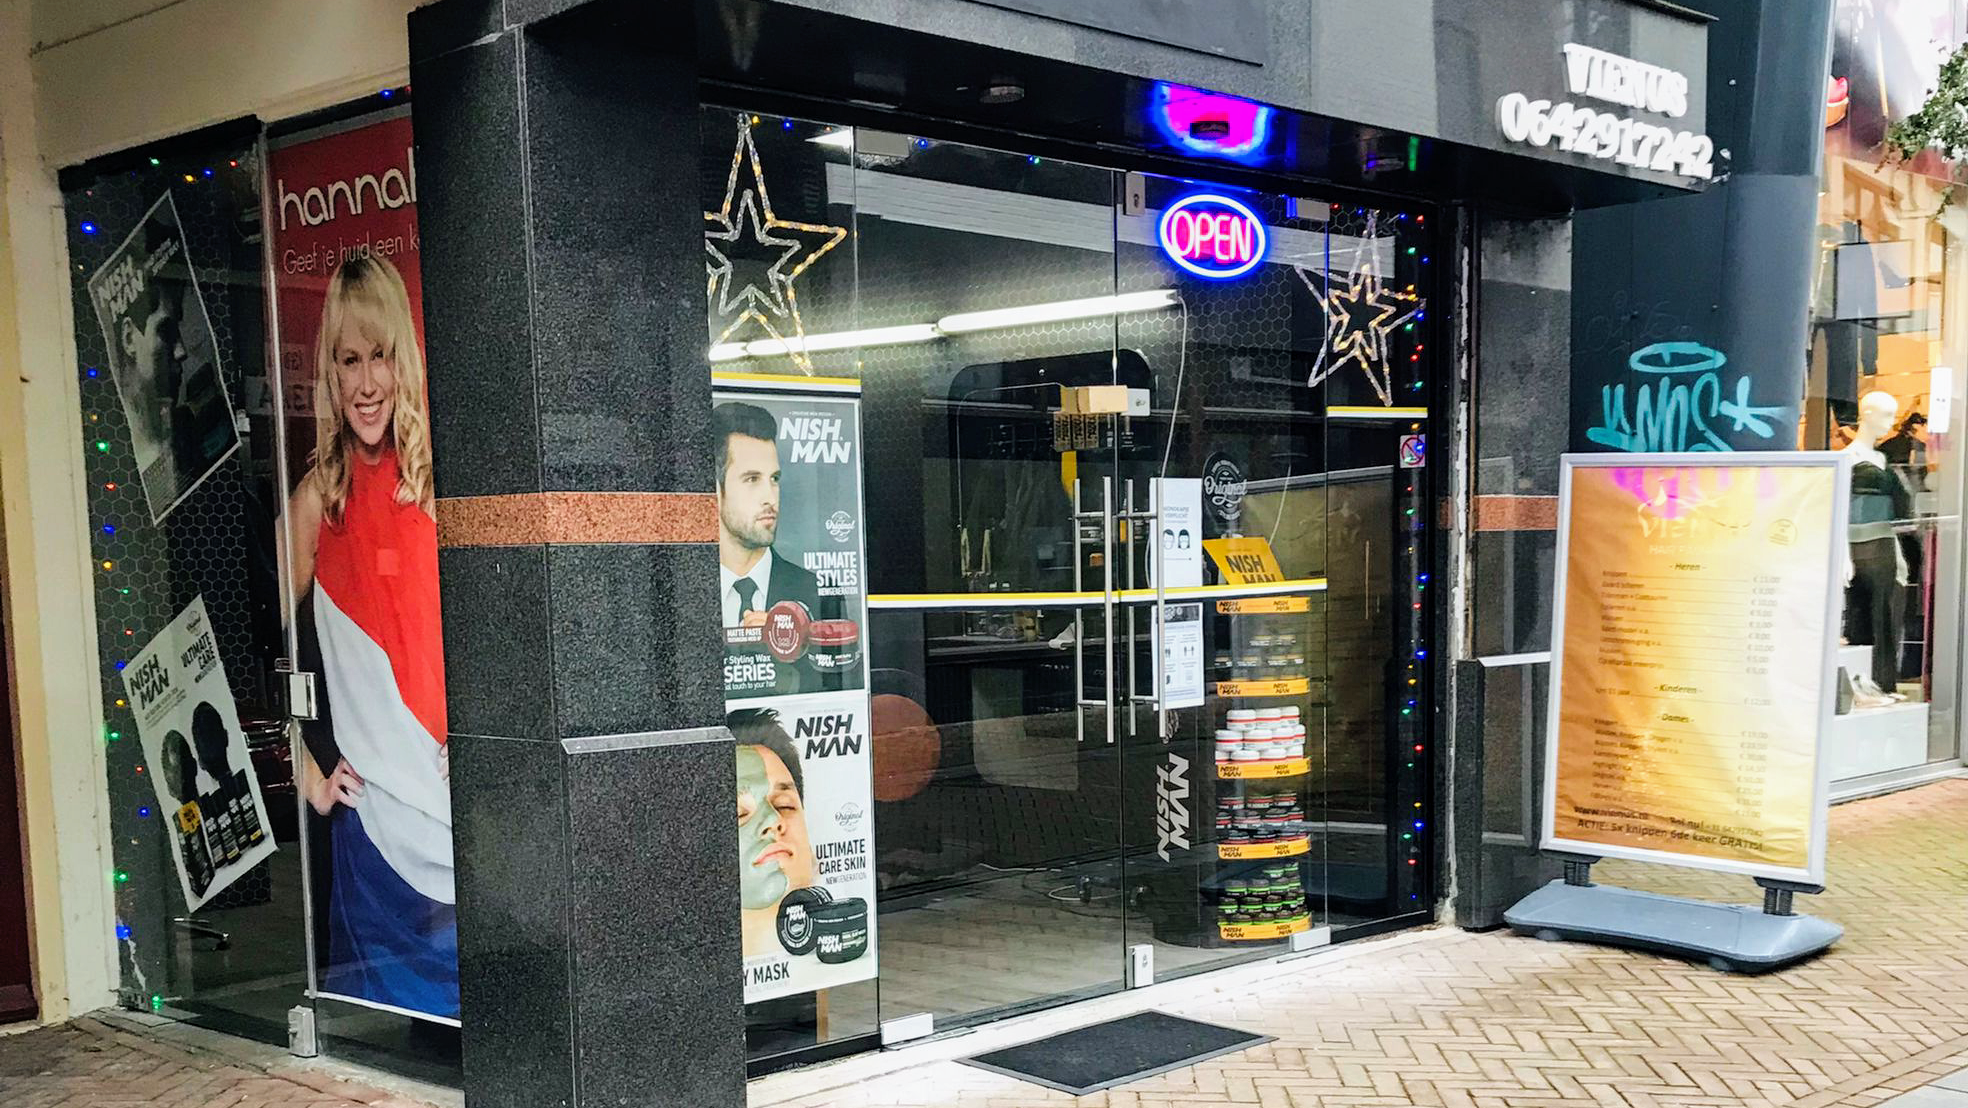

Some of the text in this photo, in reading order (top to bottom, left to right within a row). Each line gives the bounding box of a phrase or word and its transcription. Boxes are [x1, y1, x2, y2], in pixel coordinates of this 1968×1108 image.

[1563, 42, 1688, 118] VIENUS
[1498, 92, 1714, 180] 0642917242
[1171, 210, 1251, 261] OPEN
[283, 242, 317, 275] Geef
[322, 245, 335, 276] je
[339, 231, 370, 266] huid
[375, 235, 404, 257] een
[780, 417, 842, 440] NISH
[790, 441, 852, 464] MAN
[1204, 475, 1248, 505] Original
[803, 551, 857, 570] ULTIMATE
[1225, 554, 1265, 573] NISH
[816, 569, 857, 587] STYLES
[180, 631, 212, 668] ULTIMATE
[198, 646, 216, 670] CARE
[729, 655, 754, 665] Styling
[755, 654, 771, 662] Wax
[129, 654, 160, 696] NISH
[724, 663, 776, 683] SERIES
[140, 668, 170, 710] MAN
[754, 682, 765, 690] your
[795, 714, 854, 739] NISH
[805, 734, 862, 760] MAN
[1169, 752, 1190, 850] MAN
[834, 809, 864, 826] Original
[1156, 765, 1170, 862] NISH
[1626, 823, 1667, 837] knippen
[816, 838, 865, 860] ULTIMATE
[819, 856, 866, 875] CARE SKIN
[817, 935, 840, 945] NISH
[820, 943, 842, 953] MAN
[753, 961, 790, 985] MASK
